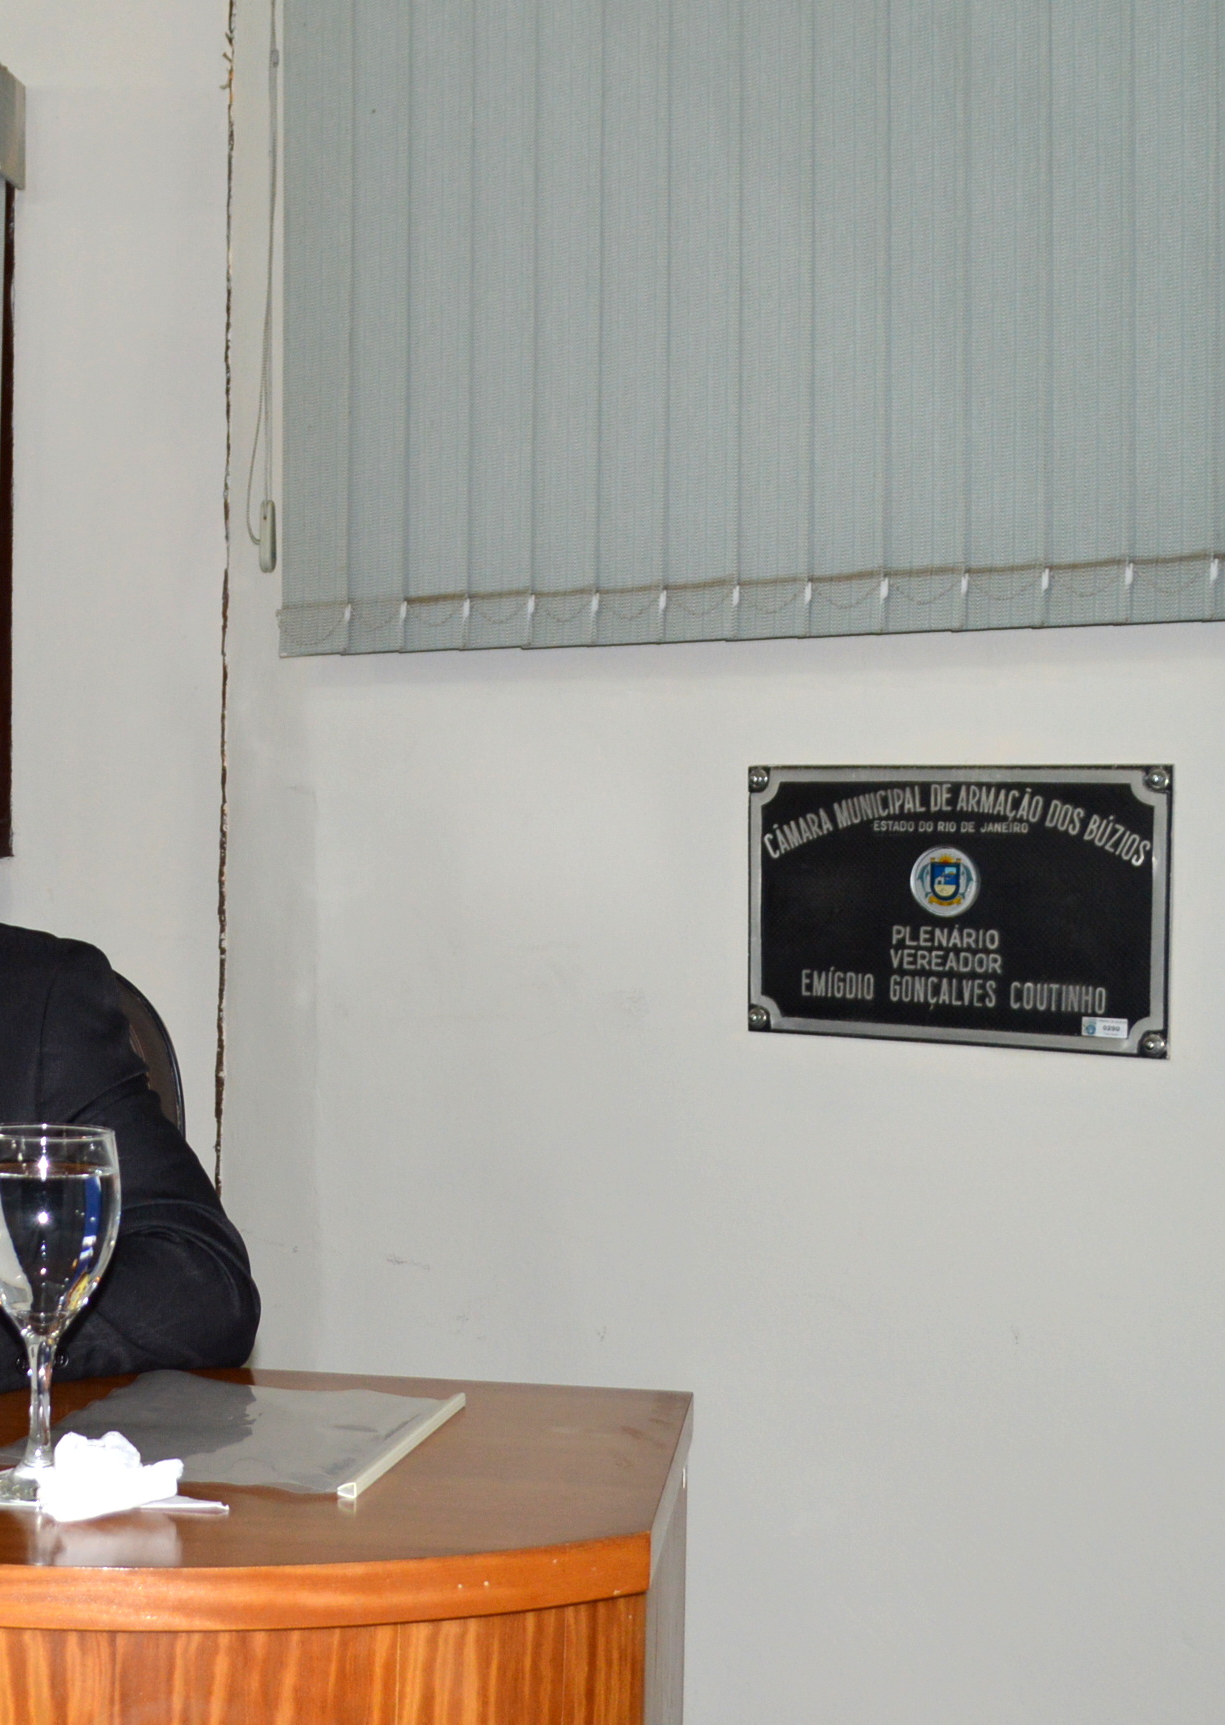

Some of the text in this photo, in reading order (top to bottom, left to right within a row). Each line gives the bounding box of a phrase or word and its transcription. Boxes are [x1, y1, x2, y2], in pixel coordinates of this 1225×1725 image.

[833, 785, 926, 830] MUNICIPAL
[930, 783, 952, 813] DE
[956, 784, 1044, 823] ARMAÇÃO
[1044, 800, 1085, 835] DOS
[1083, 814, 1151, 867] BÚZIOS
[873, 820, 1029, 834] ESTADO DO RIO DE JANEIRO
[891, 924, 999, 949] PLENÁRIO
[889, 949, 1002, 974] VEREADOR
[801, 966, 1106, 1015] EMÍGDIO GONÇALVES COUTINHO
